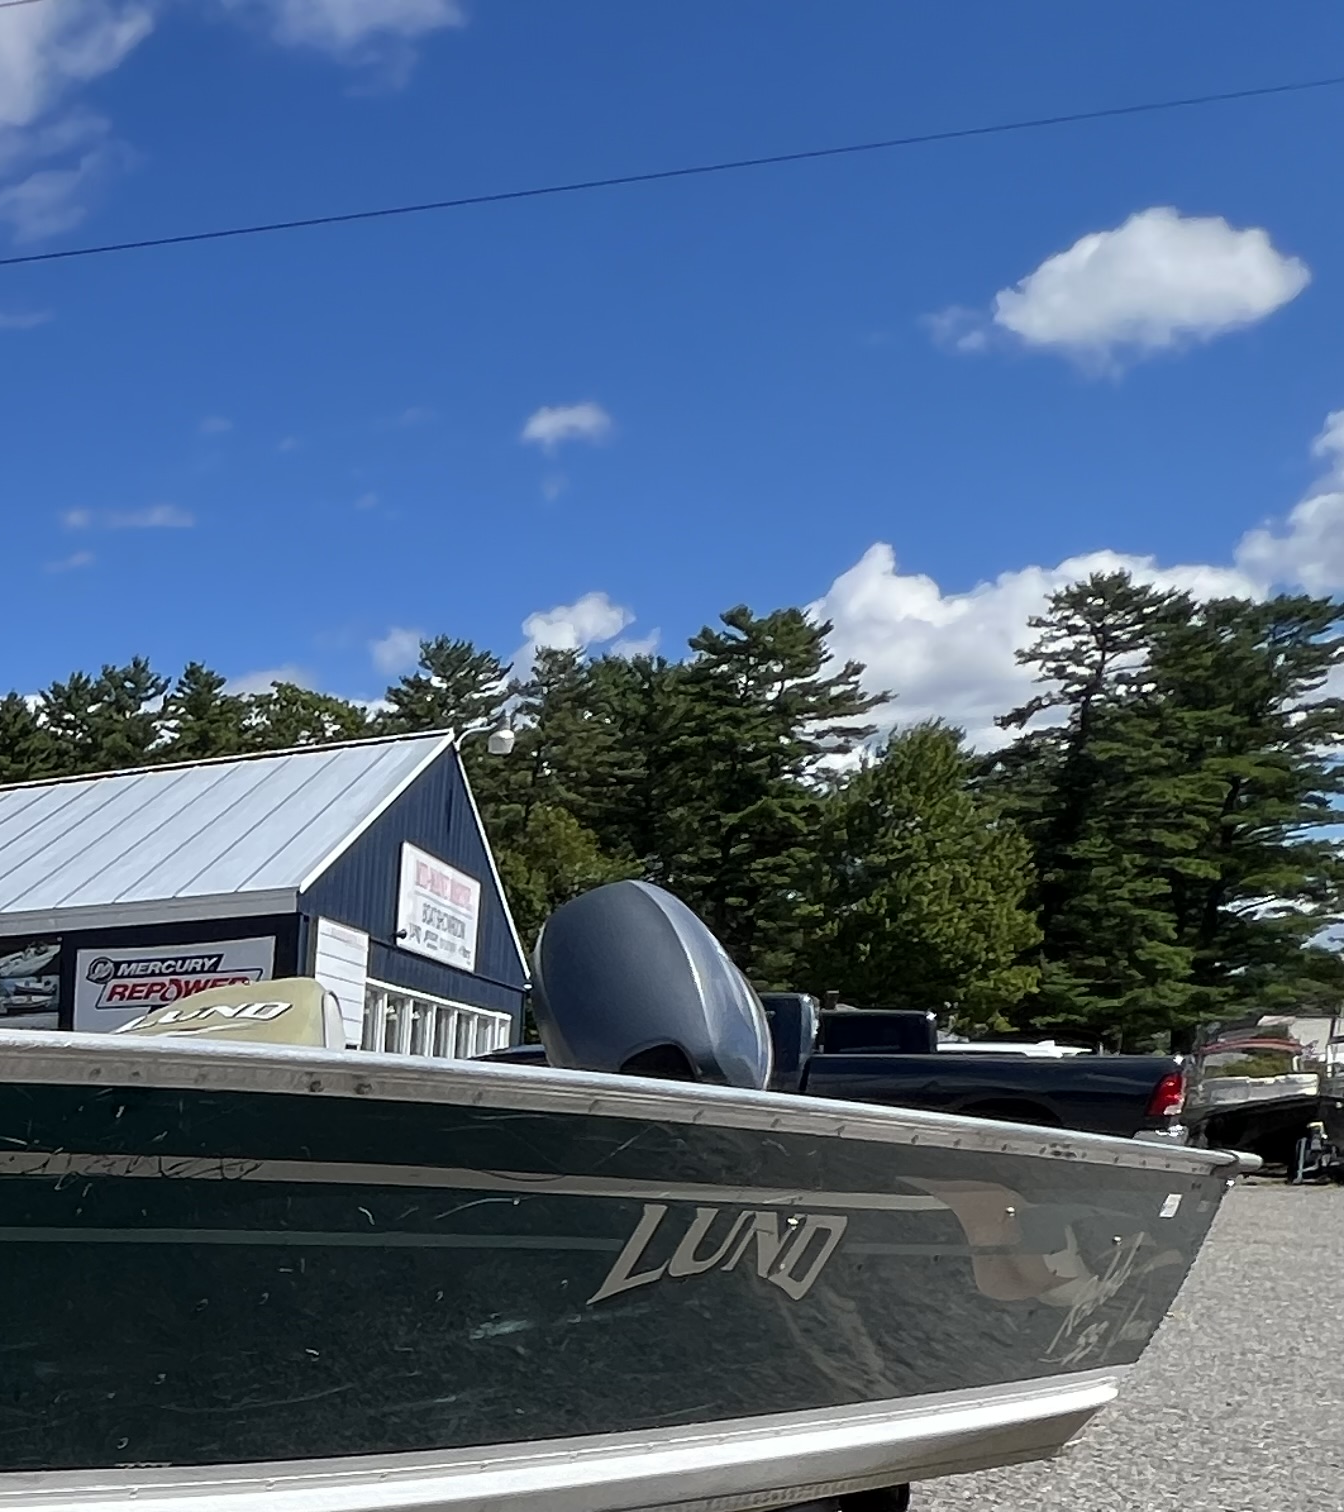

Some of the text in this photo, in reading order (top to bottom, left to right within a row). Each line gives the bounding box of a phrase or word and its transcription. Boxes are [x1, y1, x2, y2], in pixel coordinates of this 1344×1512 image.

[116, 957, 217, 977] MERCURY
[115, 1001, 294, 1033] LUND
[586, 1203, 848, 1306] LUND
